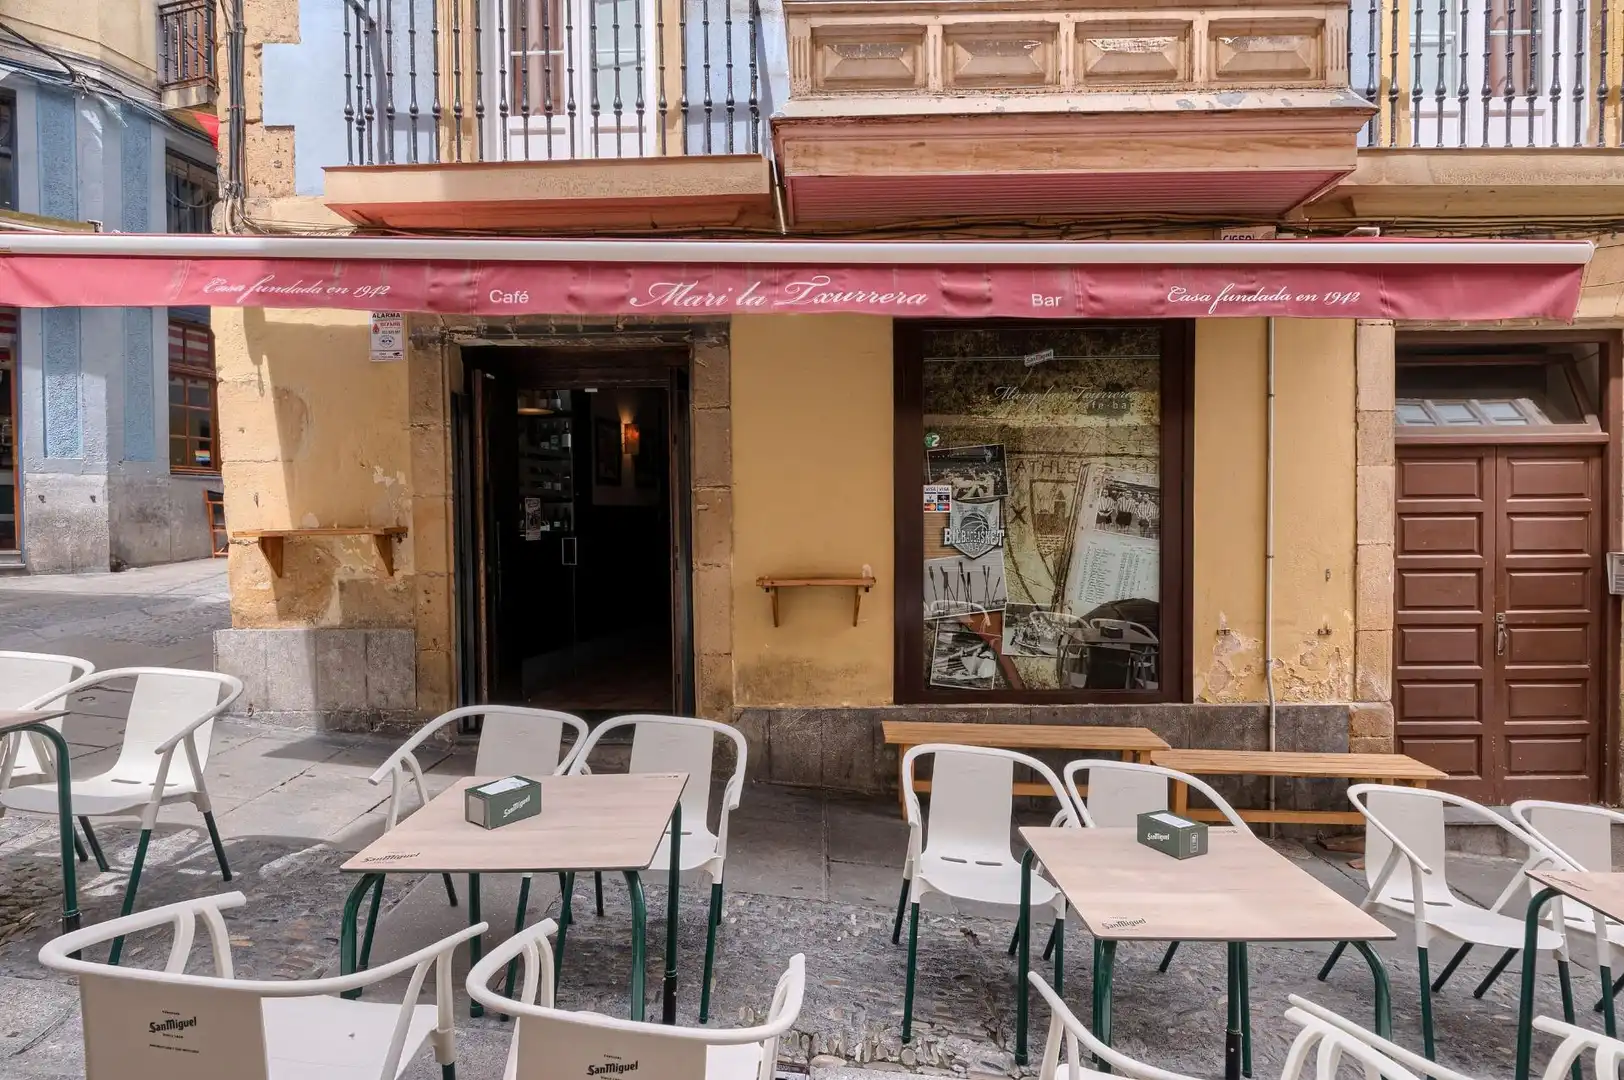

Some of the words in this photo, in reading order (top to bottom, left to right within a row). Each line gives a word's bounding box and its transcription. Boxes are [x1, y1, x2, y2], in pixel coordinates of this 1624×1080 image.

[204, 277, 245, 293] Casa
[237, 275, 322, 303] fundada
[326, 286, 350, 294] en
[353, 285, 391, 298] 1942
[489, 289, 529, 303] Café
[630, 281, 732, 307] Mari
[736, 281, 766, 306] la
[772, 275, 929, 305] Txurrera
[1167, 286, 1211, 303] Casa
[1208, 283, 1292, 314] fundada
[1296, 293, 1318, 302] en
[1323, 291, 1361, 305] 1942
[1031, 293, 1062, 307] Bar
[1015, 460, 1078, 474] ATHLE
